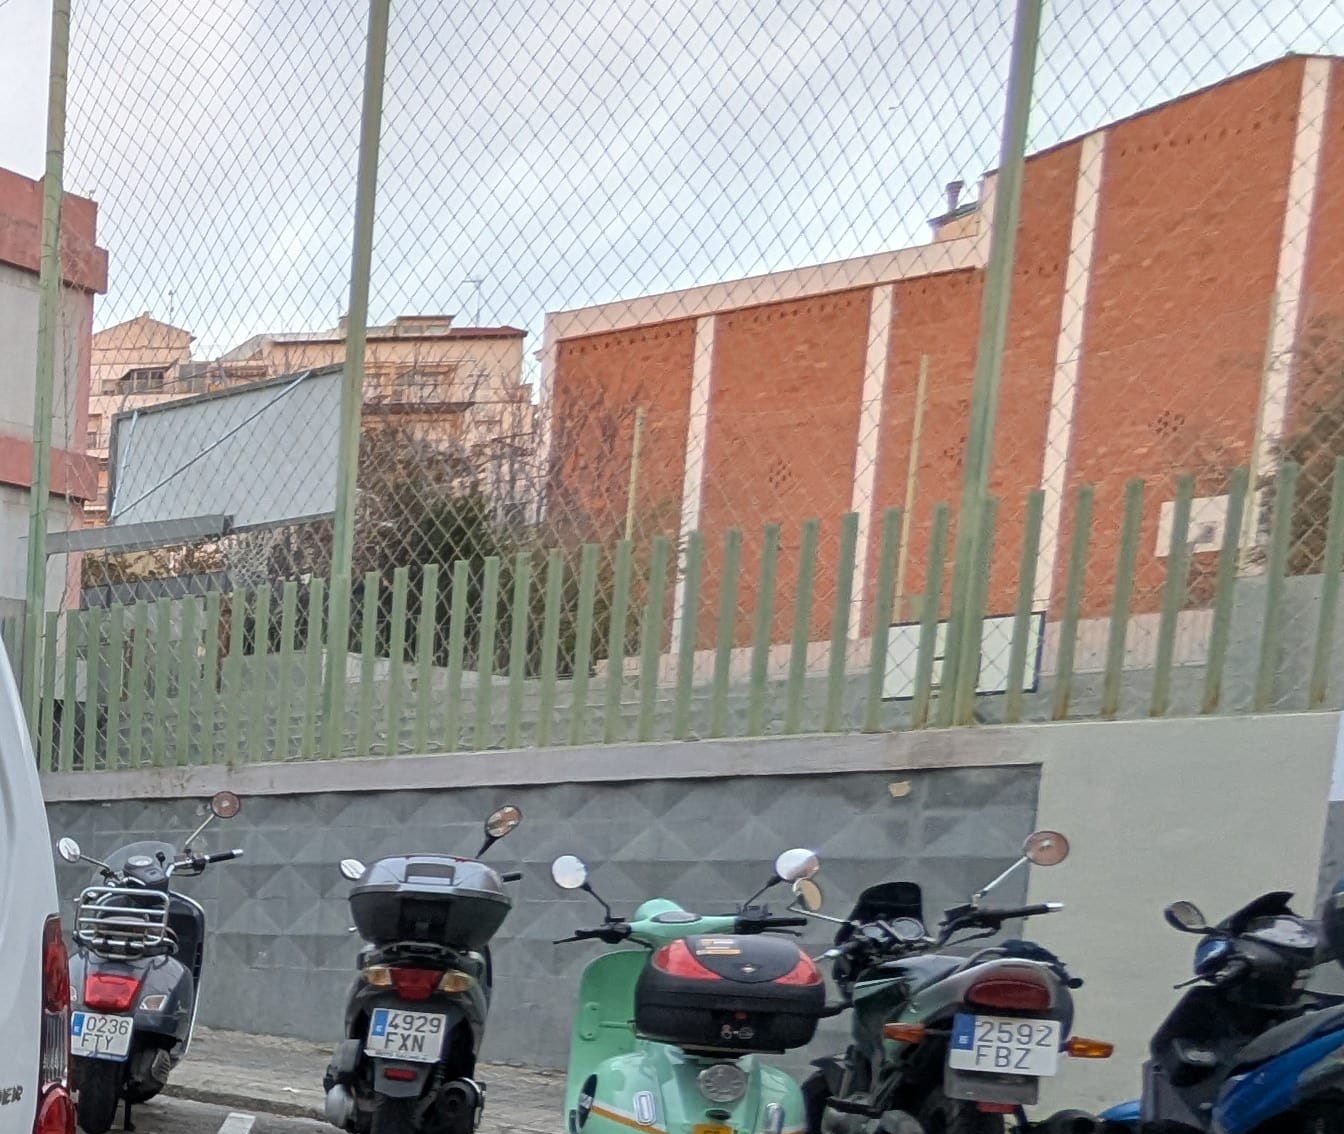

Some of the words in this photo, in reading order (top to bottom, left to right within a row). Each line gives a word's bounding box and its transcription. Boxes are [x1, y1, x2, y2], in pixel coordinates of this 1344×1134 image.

[86, 1016, 130, 1036] 0236
[388, 1013, 442, 1034] 4929
[975, 1020, 1053, 1048] 2592
[81, 1032, 114, 1051] FTY
[384, 1032, 426, 1053] FXN
[975, 1044, 1032, 1070] FBZ
